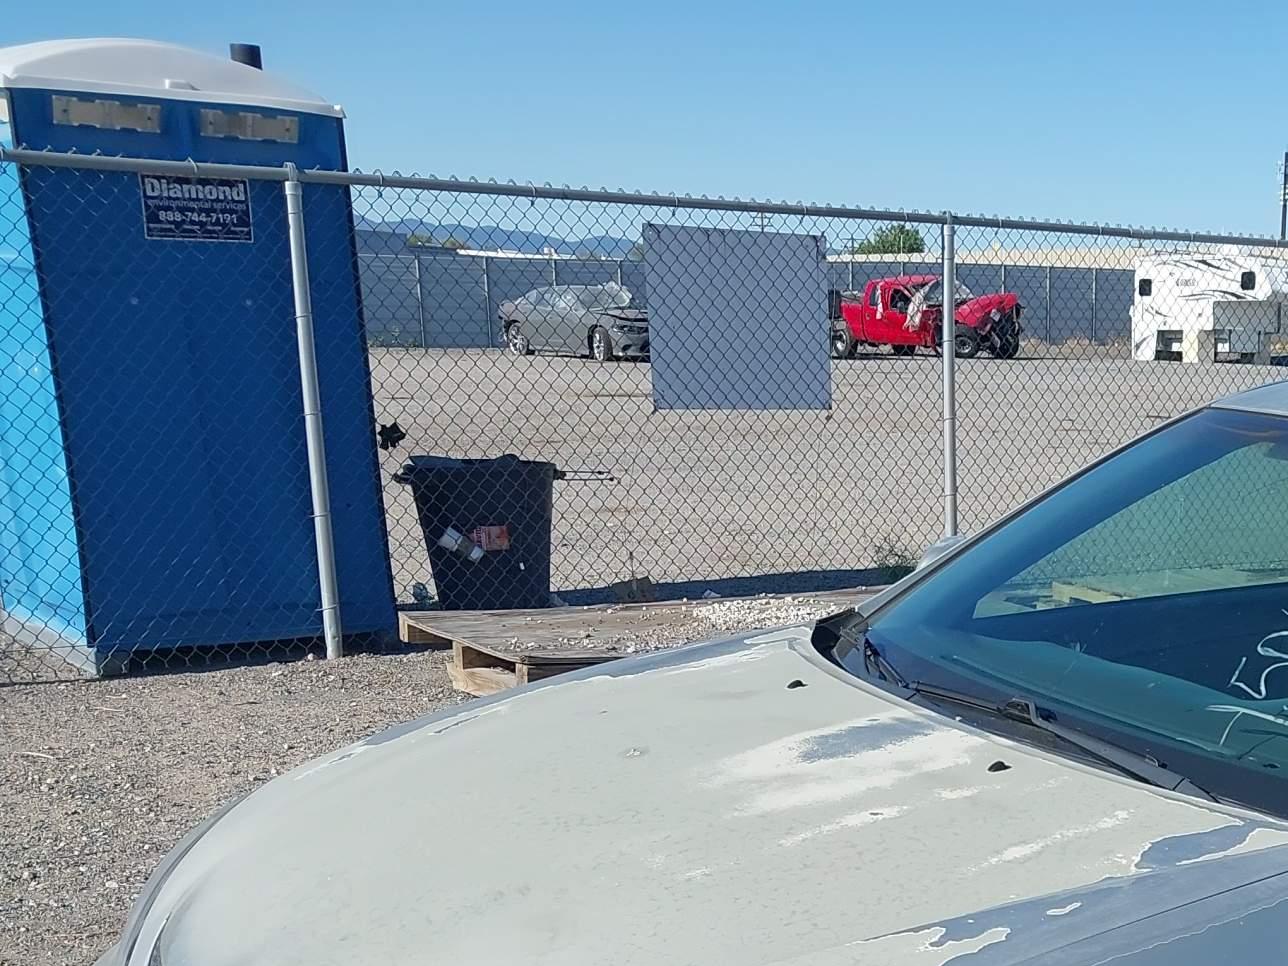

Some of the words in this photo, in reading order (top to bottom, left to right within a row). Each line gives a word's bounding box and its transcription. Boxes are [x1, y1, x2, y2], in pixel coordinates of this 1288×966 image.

[144, 178, 246, 200] Diamond
[147, 199, 211, 210] environmental
[213, 200, 247, 210] services
[159, 210, 238, 224] 888-744-7191
